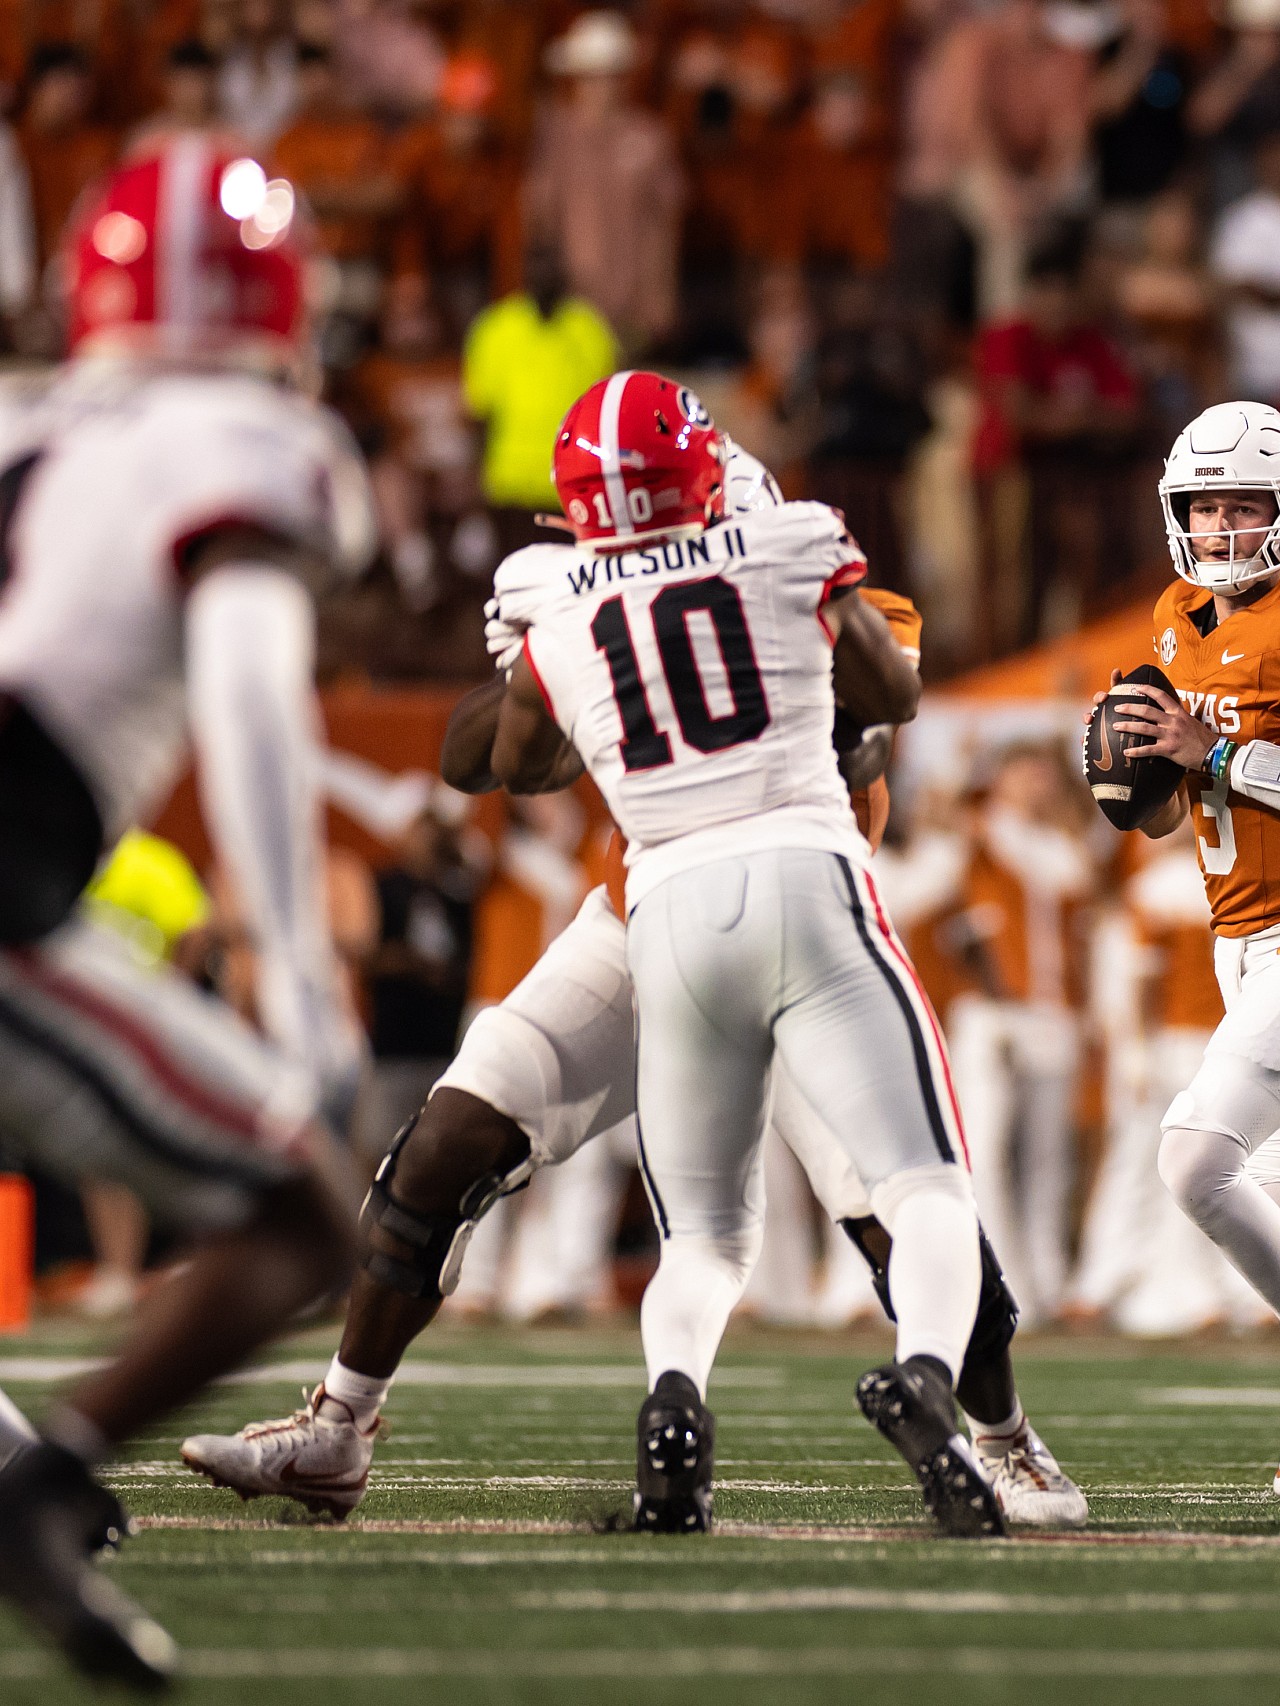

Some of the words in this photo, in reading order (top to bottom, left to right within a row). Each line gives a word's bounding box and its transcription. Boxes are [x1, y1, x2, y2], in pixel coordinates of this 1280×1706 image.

[1194, 467, 1225, 477] HORNS
[593, 487, 653, 528] 10
[568, 538, 709, 594] WILSON
[724, 528, 746, 557] II
[590, 575, 771, 773] 10
[1176, 689, 1241, 734] XAS
[1199, 774, 1238, 875] 3
